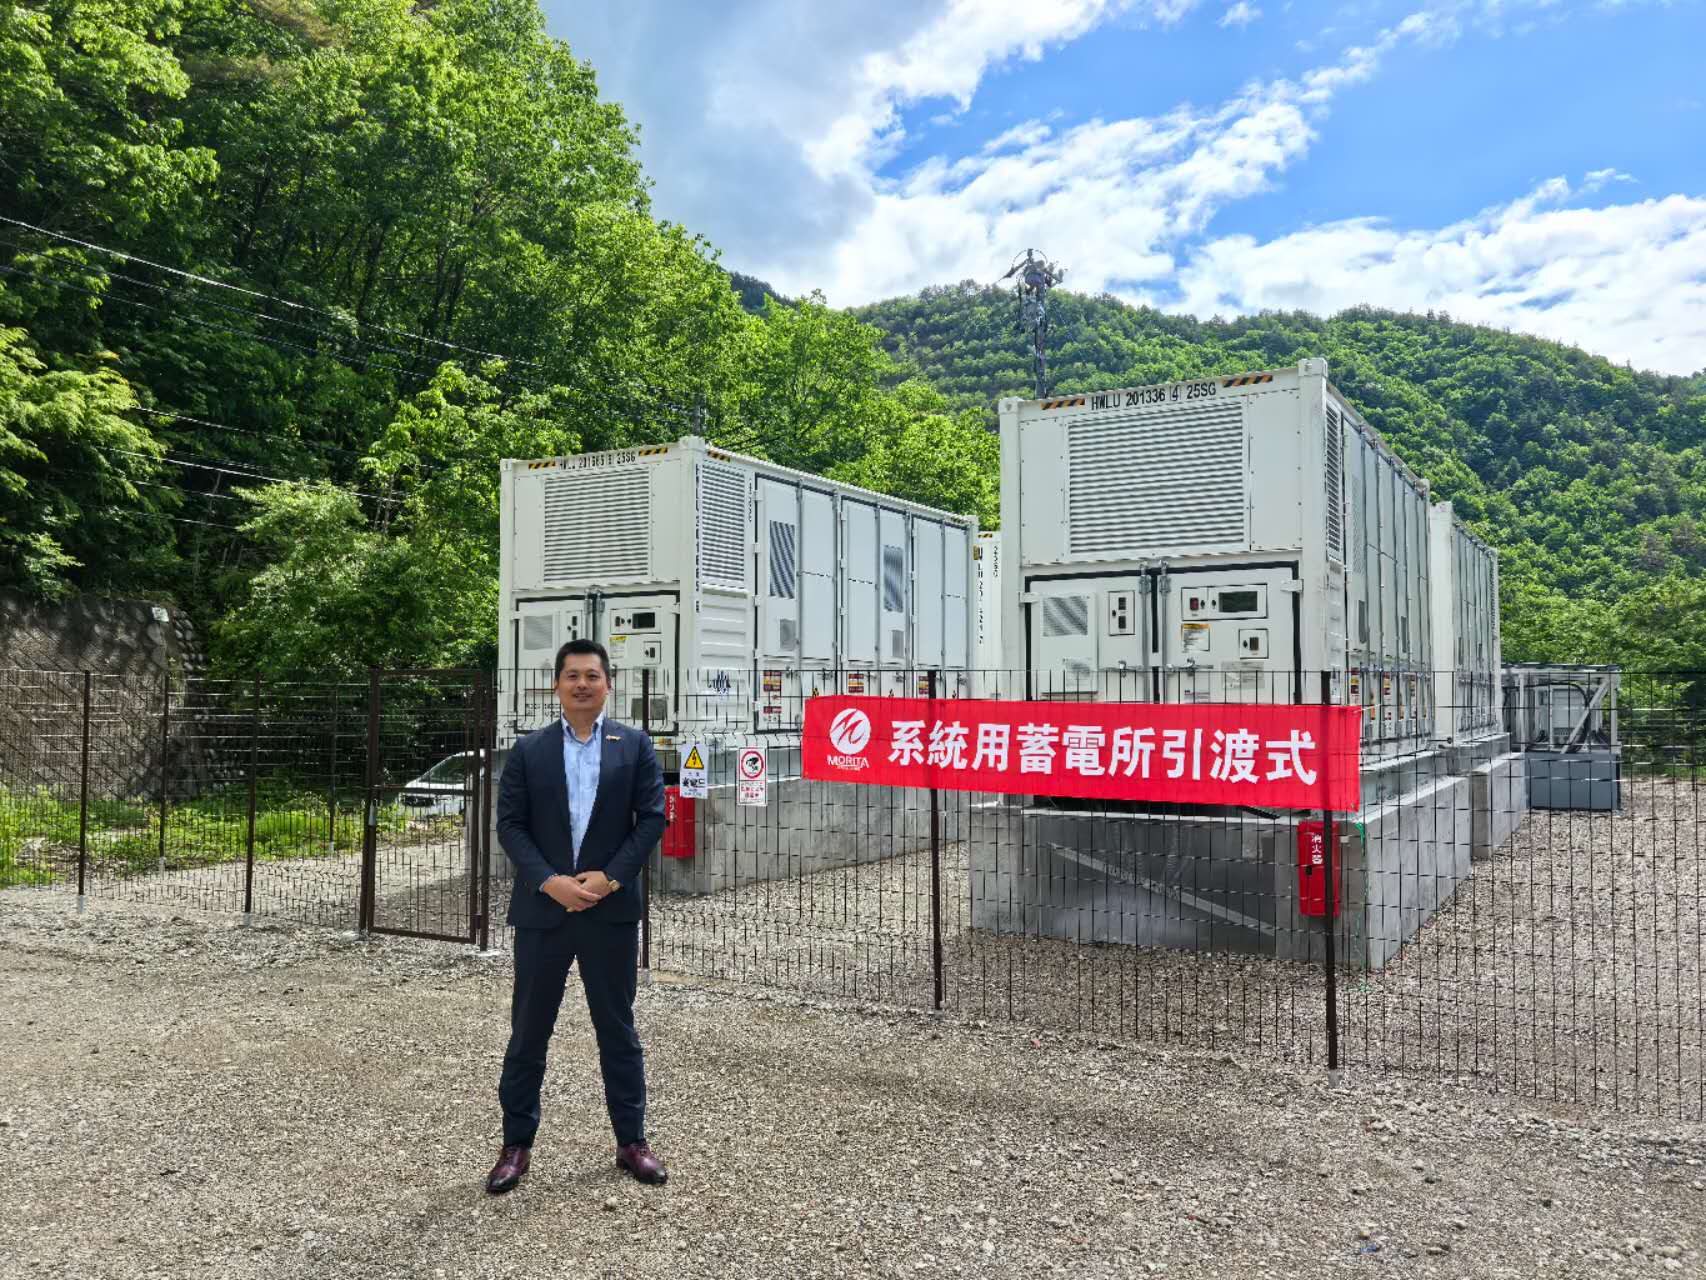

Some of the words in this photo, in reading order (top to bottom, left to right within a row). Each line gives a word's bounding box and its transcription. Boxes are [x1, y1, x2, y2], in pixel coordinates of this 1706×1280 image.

[1091, 392, 1121, 411] HWLU
[1126, 388, 1166, 407] 201336
[1170, 385, 1181, 402] 4
[1186, 382, 1217, 400] 25SG
[826, 754, 870, 769] MORITA
[888, 719, 1318, 786] 系統用蓄電所引渡式
